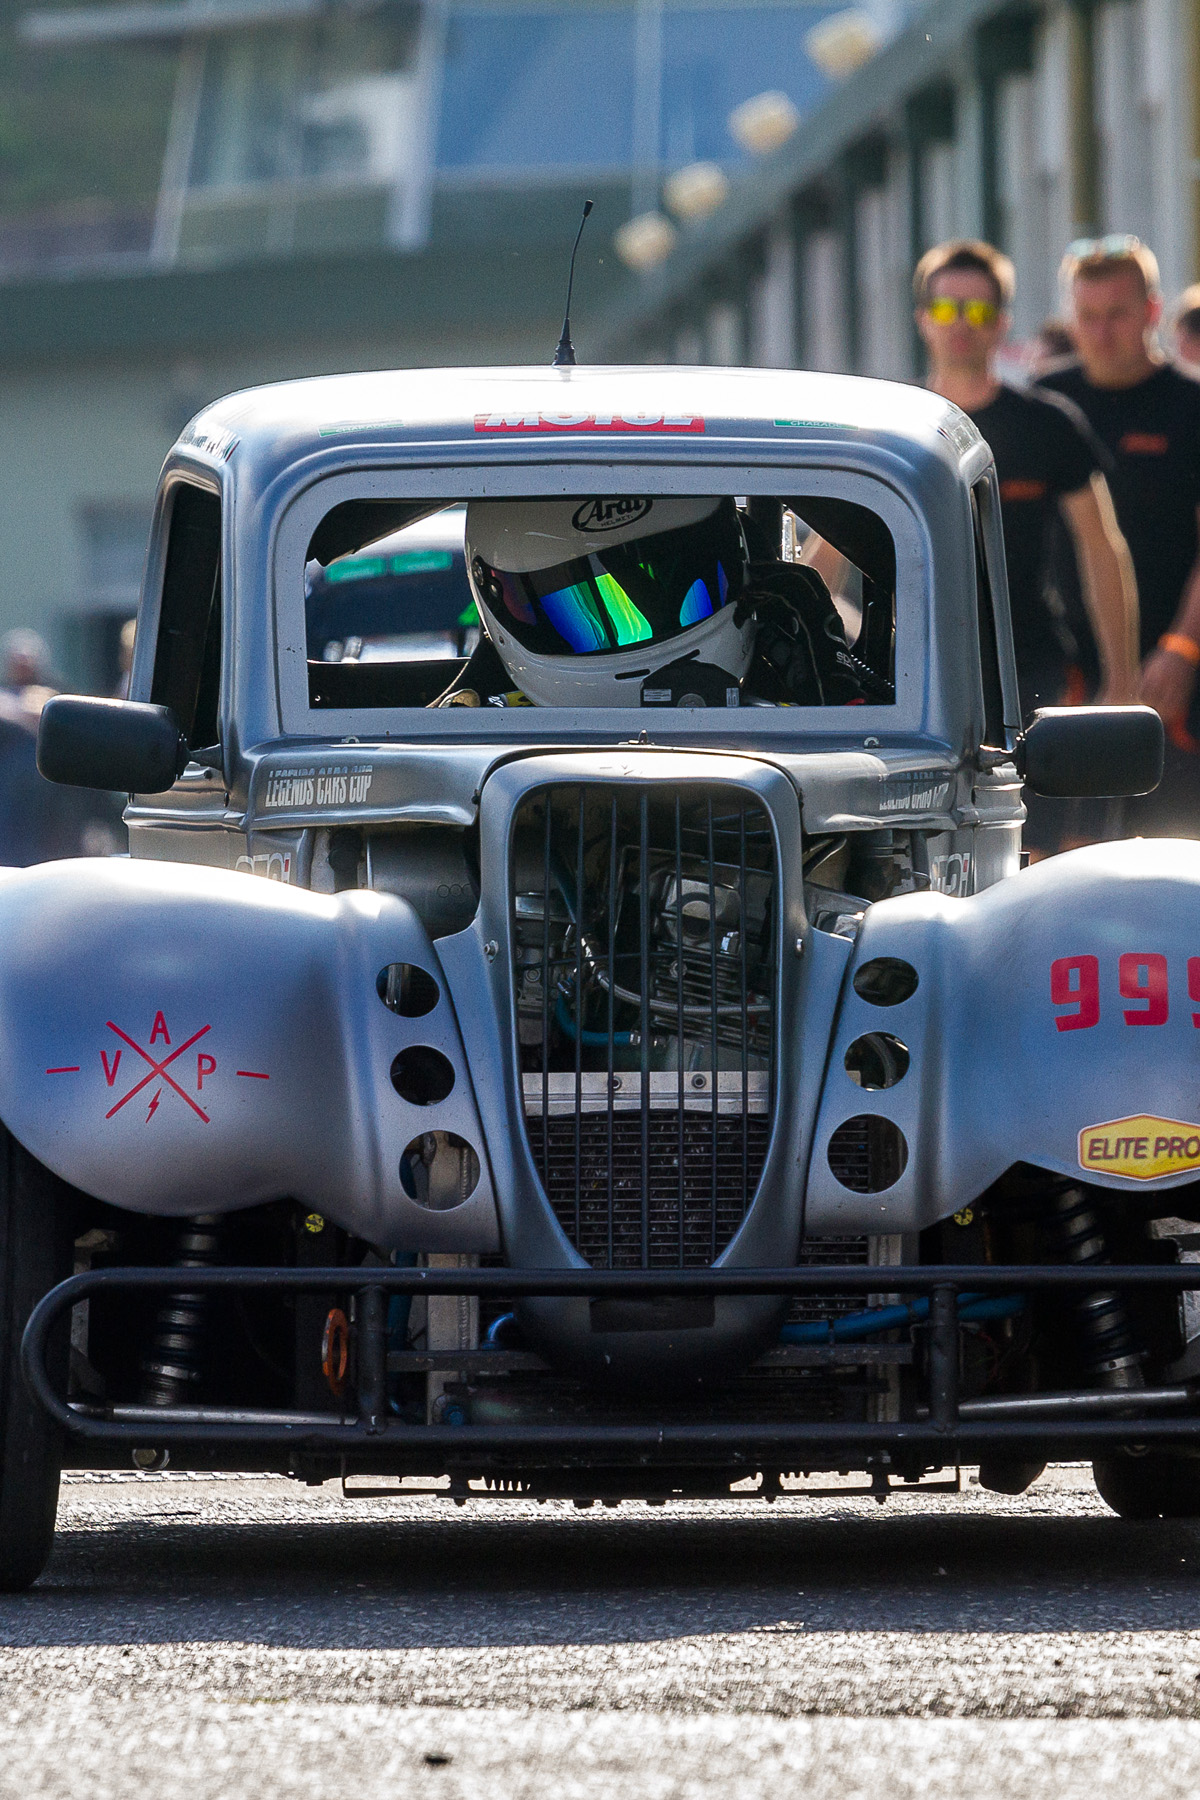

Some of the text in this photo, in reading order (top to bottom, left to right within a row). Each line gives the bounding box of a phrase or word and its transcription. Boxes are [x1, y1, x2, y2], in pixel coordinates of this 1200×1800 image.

[265, 774, 373, 807] LEGENDS CARS CUP
[1050, 952, 1200, 1032] 99
[1088, 1135, 1200, 1160] ELITE PRO
